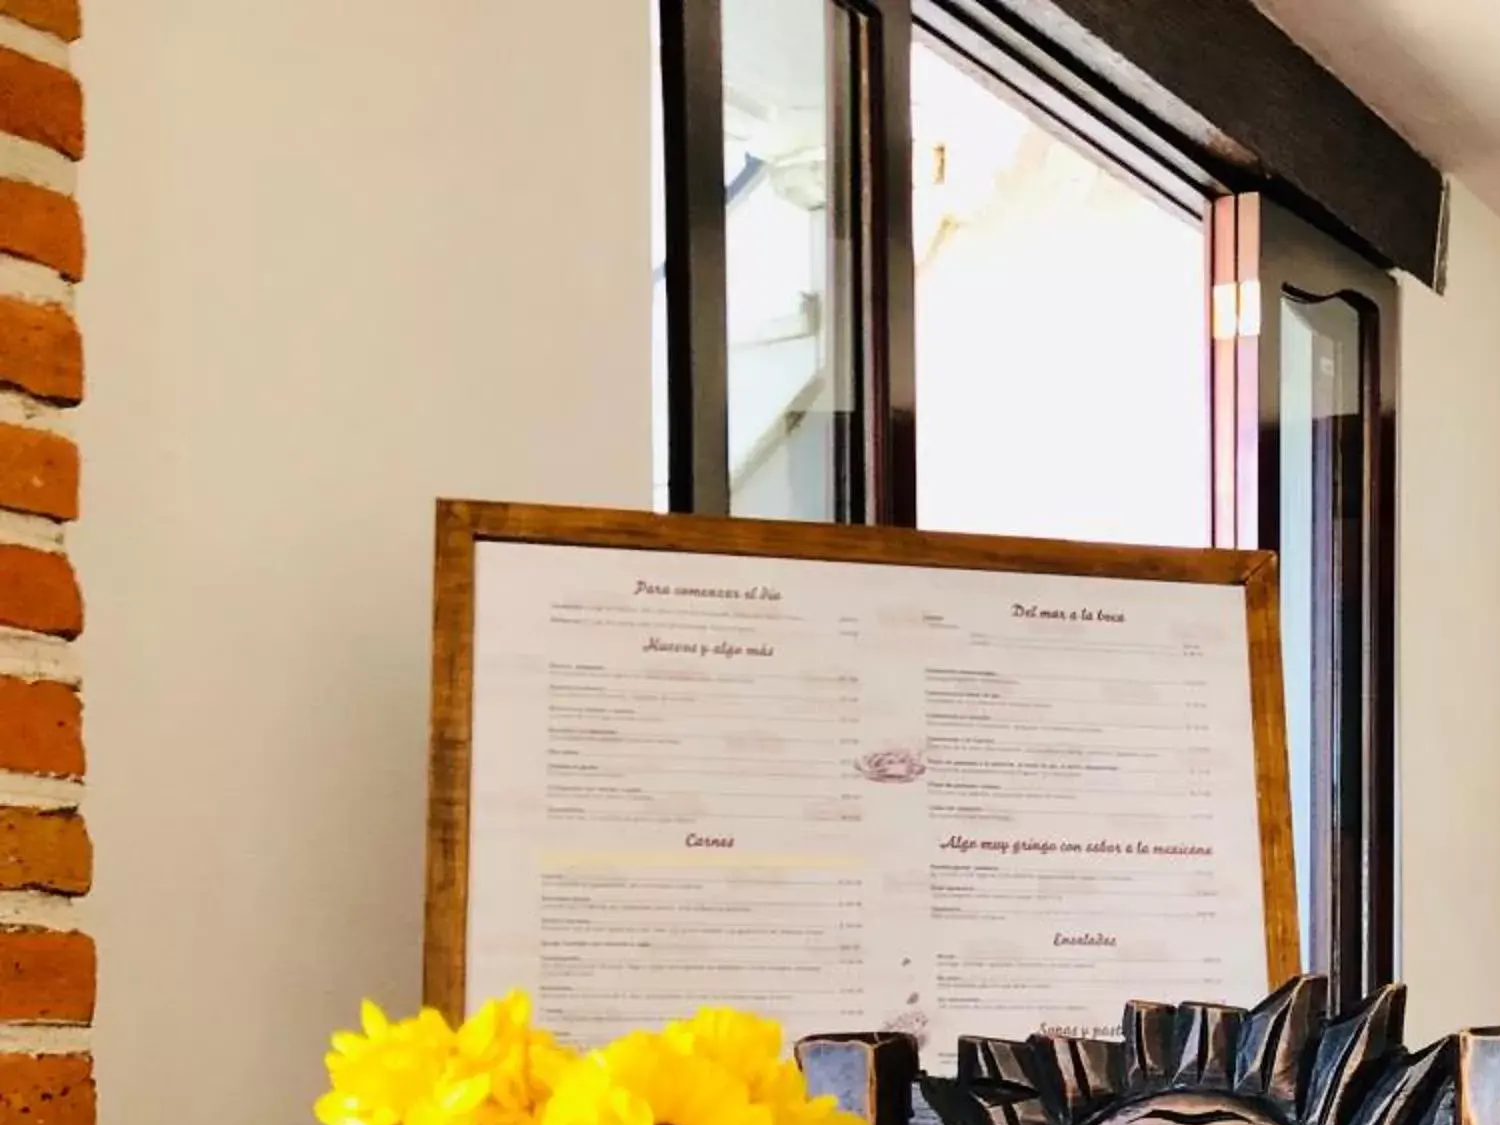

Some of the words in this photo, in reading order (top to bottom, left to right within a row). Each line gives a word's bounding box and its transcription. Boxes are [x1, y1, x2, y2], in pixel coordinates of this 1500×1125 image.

[632, 580, 670, 595] Para
[674, 586, 740, 599] comenzar
[745, 586, 758, 600] el
[1011, 603, 1038, 618] Del
[1039, 609, 1066, 621] mar
[1069, 611, 1077, 620] a
[1081, 607, 1093, 621] la
[1097, 608, 1125, 623] boca
[642, 637, 697, 653] Huevos
[700, 645, 709, 656] y
[713, 641, 743, 658] algo
[746, 643, 774, 657] más
[685, 833, 735, 848] Carnes
[939, 835, 978, 852] Algo
[981, 840, 1009, 854] muy
[1012, 839, 1057, 854] gringo
[1060, 842, 1082, 853] con
[1085, 840, 1121, 853] sabor
[1125, 844, 1133, 853] a
[1137, 840, 1149, 854] la
[1152, 843, 1212, 855] mexicana
[1053, 932, 1118, 946] Ensaladas
